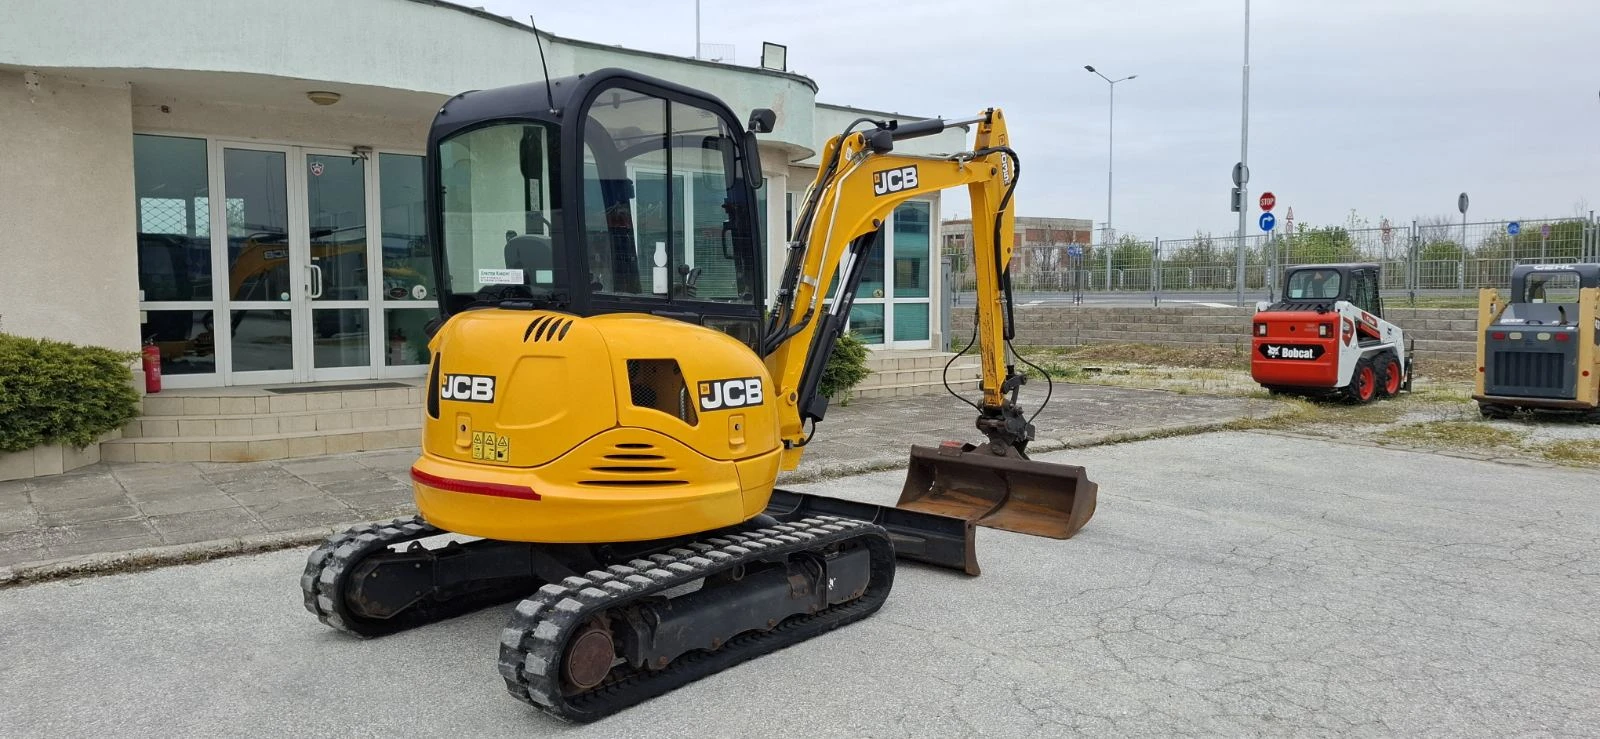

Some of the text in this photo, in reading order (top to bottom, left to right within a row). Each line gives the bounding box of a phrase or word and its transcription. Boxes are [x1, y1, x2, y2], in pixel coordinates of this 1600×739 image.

[874, 166, 918, 195] JCB
[1260, 197, 1274, 206] STOP
[1281, 347, 1313, 359] Bobcat
[441, 375, 494, 401] JCB
[701, 379, 763, 409] JCB
